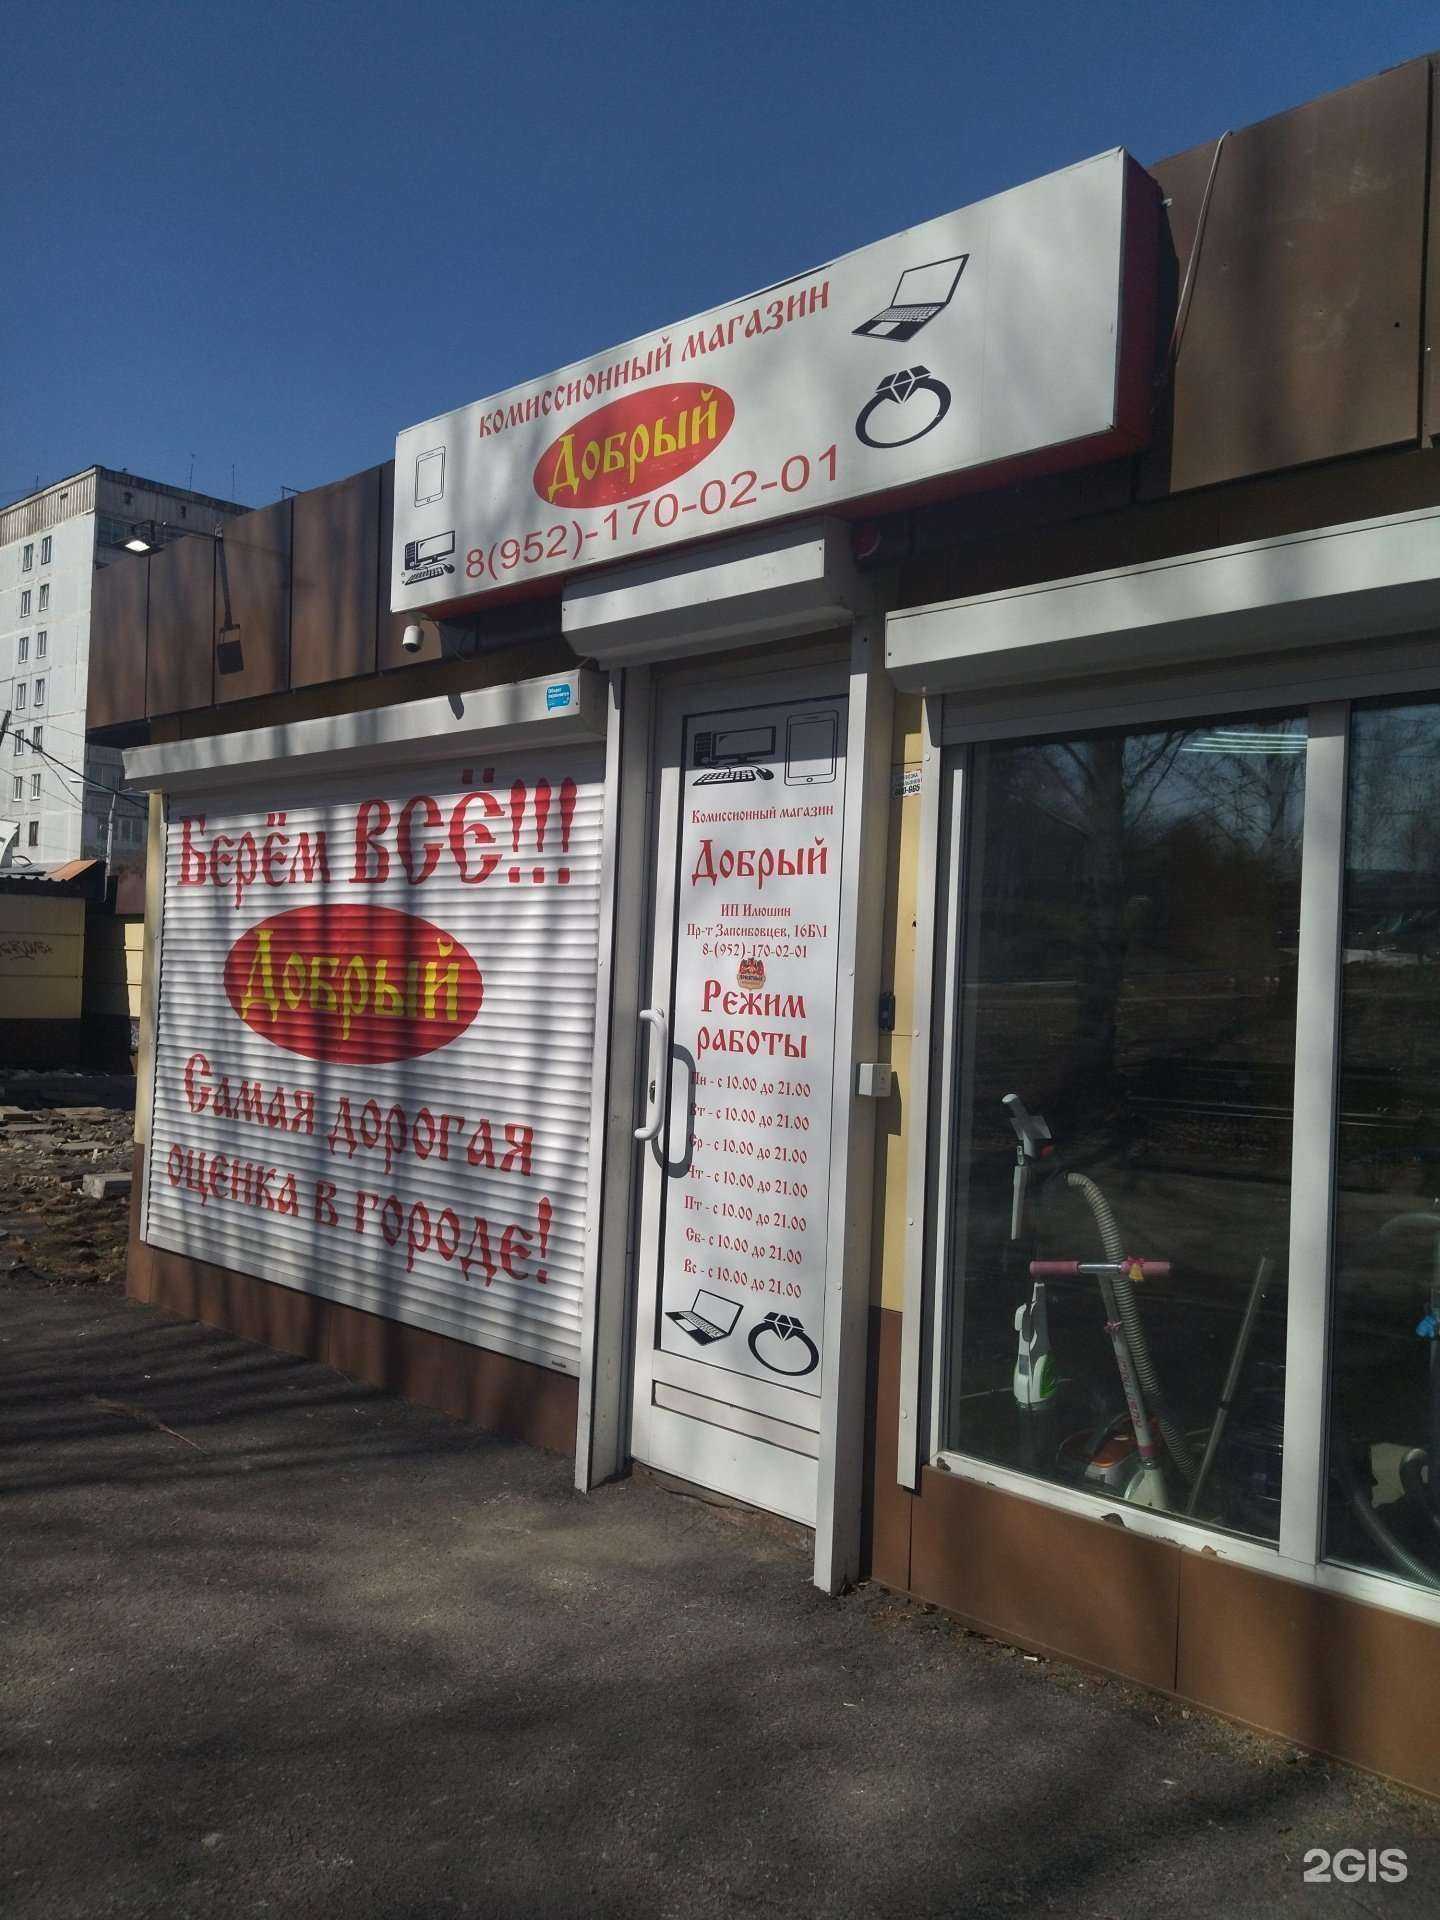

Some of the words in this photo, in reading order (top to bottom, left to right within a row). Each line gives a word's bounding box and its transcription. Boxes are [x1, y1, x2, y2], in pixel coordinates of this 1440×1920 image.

[547, 387, 719, 504] Добрый
[465, 444, 838, 579] 8(952)-170-02-01
[692, 807, 776, 823] Комиссионный
[779, 804, 834, 819] магазин
[177, 812, 330, 909] Берём
[348, 767, 578, 885] ВСЁ!!!
[691, 835, 828, 890] Добрый
[720, 903, 739, 917] ИП
[743, 903, 791, 917] Илюшин
[687, 924, 713, 939] Пр-т
[794, 924, 828, 938] 16Б\1
[702, 942, 808, 958] 8-(952)-170-02-01
[240, 929, 460, 1041] Добрый
[701, 979, 806, 1019] Режим
[697, 1026, 807, 1060] работы
[717, 1078, 722, 1087] с
[727, 1075, 757, 1091] 10.00
[761, 1083, 774, 1095] до
[778, 1081, 811, 1097] 21.00
[184, 1053, 315, 1137] Самая
[327, 1098, 535, 1177] дорогая
[716, 1109, 721, 1119] с
[725, 1107, 756, 1123] 10.00
[759, 1115, 773, 1128] до
[777, 1114, 810, 1130] 21.00
[714, 1140, 719, 1150] с
[723, 1139, 754, 1155] 10.00
[757, 1147, 770, 1160] до
[775, 1147, 807, 1164] 21.00
[714, 1172, 720, 1182] с
[724, 1171, 753, 1188] 10.00
[757, 1181, 771, 1193] до
[775, 1180, 808, 1197] 21.00
[167, 1143, 299, 1219] оценка
[315, 1180, 340, 1227] в
[355, 1190, 553, 1287] городе!
[684, 1195, 702, 1210] Пт
[713, 1204, 718, 1214] с
[722, 1203, 753, 1220] 10.00
[756, 1214, 770, 1226] до
[774, 1212, 807, 1231] 21.00
[718, 1234, 749, 1253] 10.00
[751, 1246, 765, 1259] до
[769, 1245, 802, 1264] 21.00
[683, 1258, 697, 1273] Вс
[708, 1267, 713, 1277] с
[717, 1266, 748, 1285] 10.00
[751, 1278, 765, 1291] до
[768, 1278, 802, 1298] 21.00
